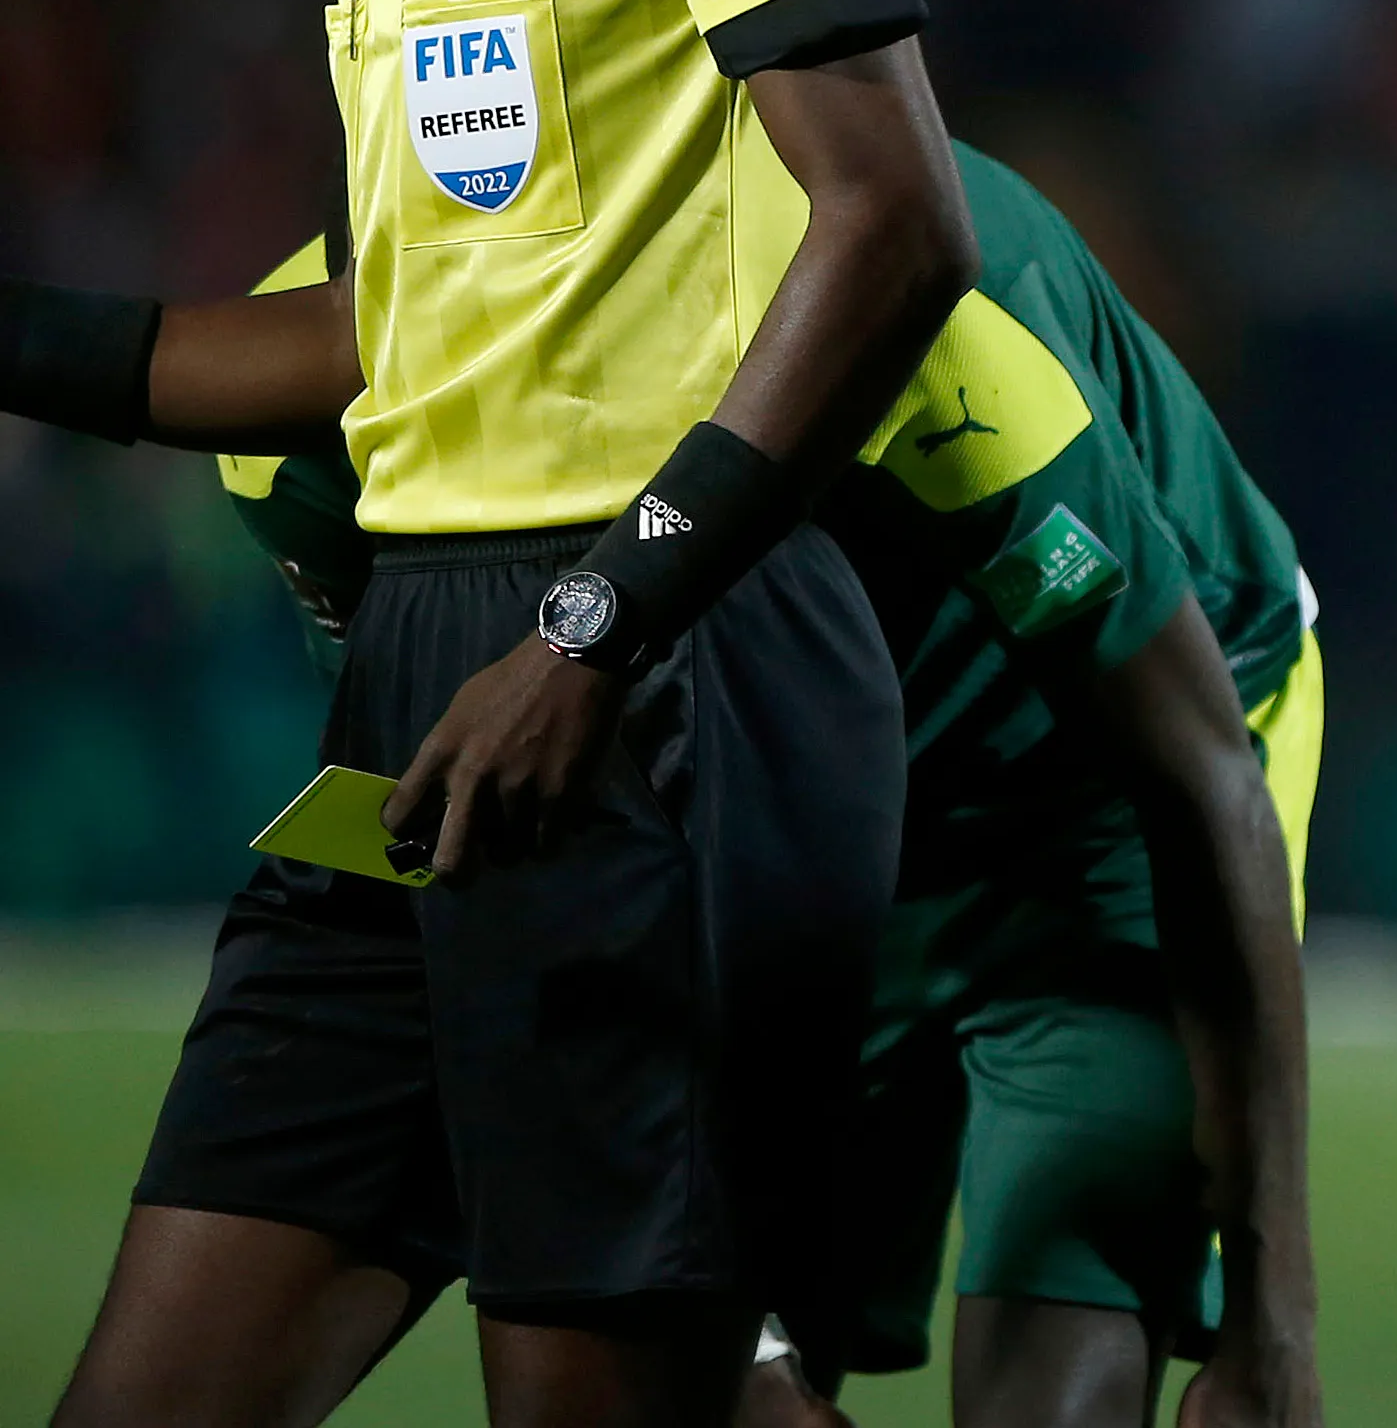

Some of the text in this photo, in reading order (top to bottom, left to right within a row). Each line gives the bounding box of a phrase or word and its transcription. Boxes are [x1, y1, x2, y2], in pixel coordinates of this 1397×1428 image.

[415, 29, 517, 83] FIFA
[420, 104, 527, 139] REFEREE
[458, 172, 511, 196] 2022
[640, 493, 693, 532] adidas
